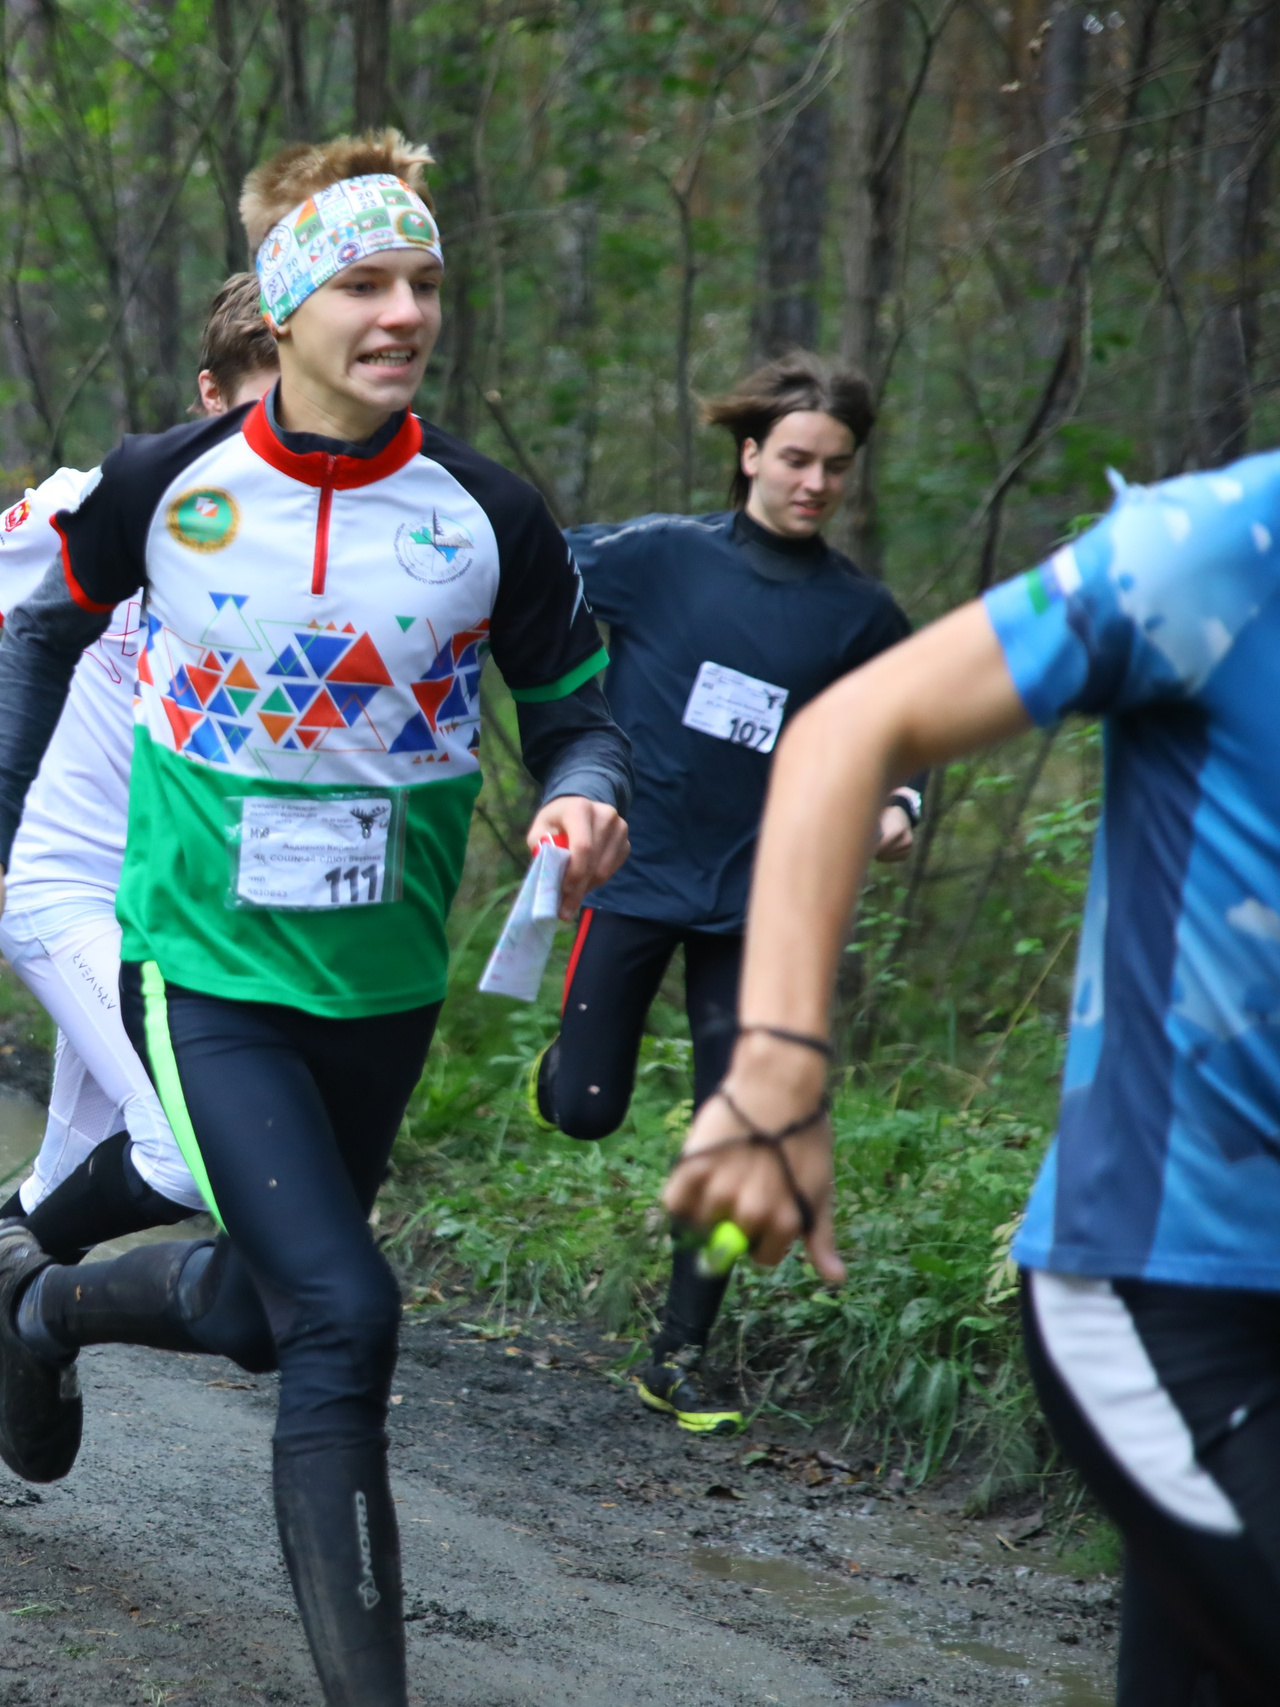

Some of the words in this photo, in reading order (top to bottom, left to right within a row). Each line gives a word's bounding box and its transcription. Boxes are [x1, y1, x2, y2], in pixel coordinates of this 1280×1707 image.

[730, 717, 772, 749] 107
[325, 864, 378, 903] 111
[355, 1490, 373, 1577] NORD
